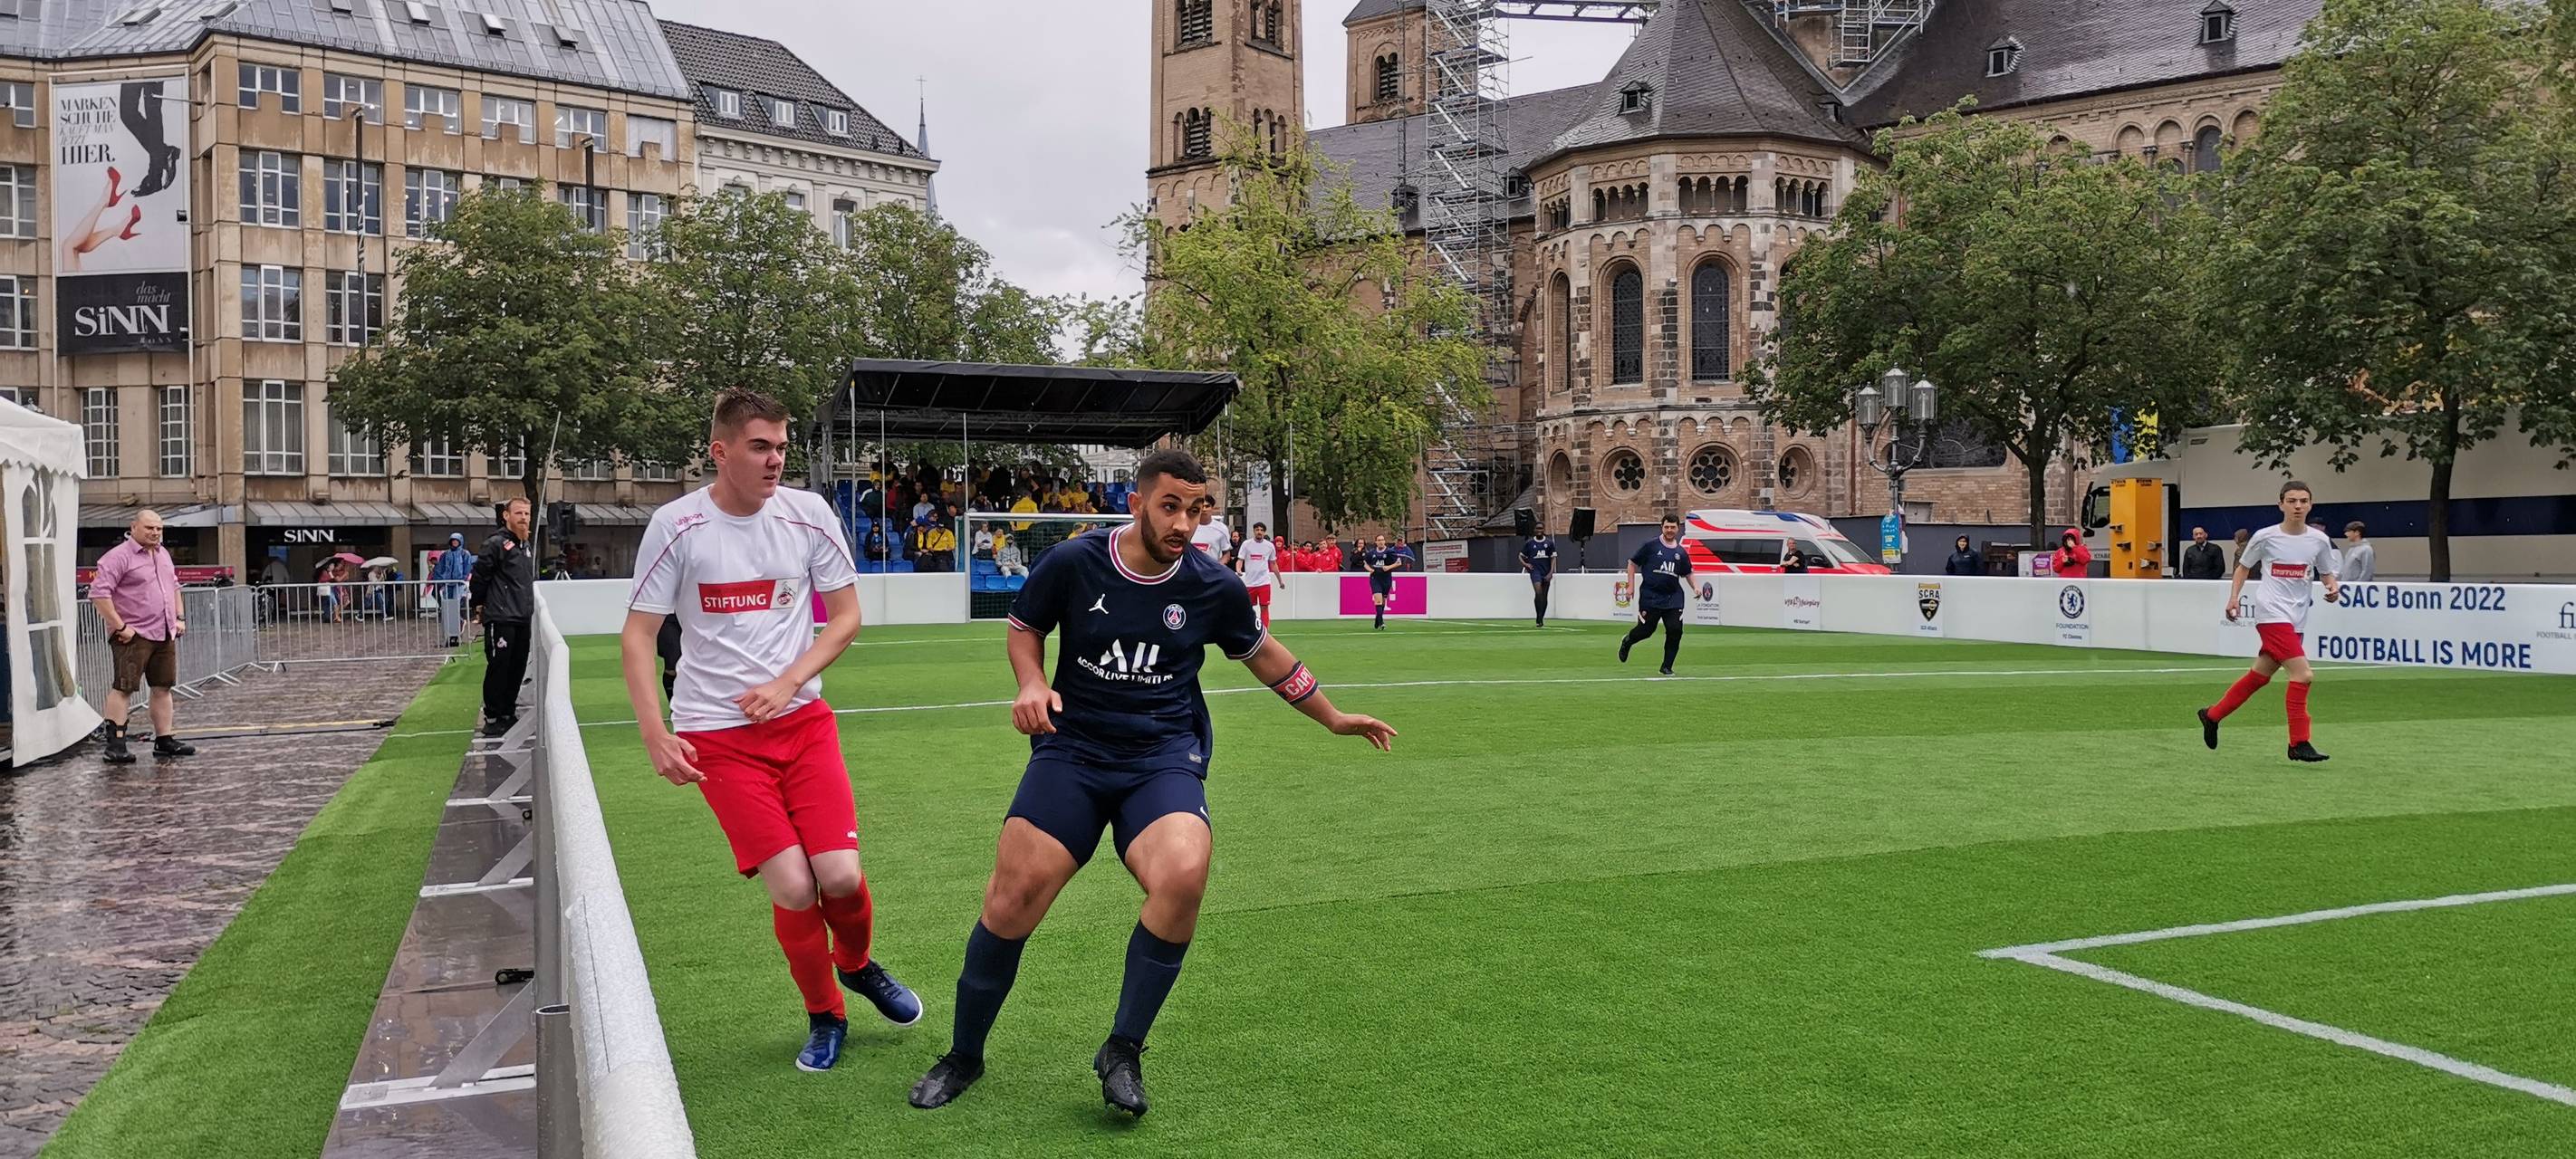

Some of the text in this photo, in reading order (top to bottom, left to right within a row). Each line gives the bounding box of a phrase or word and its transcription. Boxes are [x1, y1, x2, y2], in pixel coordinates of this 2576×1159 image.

[61, 97, 116, 110] MARKEN
[60, 110, 116, 124] SCHUHE
[62, 144, 116, 164] HIER.
[136, 281, 158, 294] das
[137, 291, 171, 303] macht
[75, 305, 171, 336] SiNN
[704, 593, 767, 609] STIFTUNG
[2340, 584, 2505, 611] SAC Bonn 2022
[2318, 636, 2532, 668] FOOTBALL IS MORE
[1077, 656, 1106, 678] ACCOR
[1105, 671, 1129, 681] LIVE
